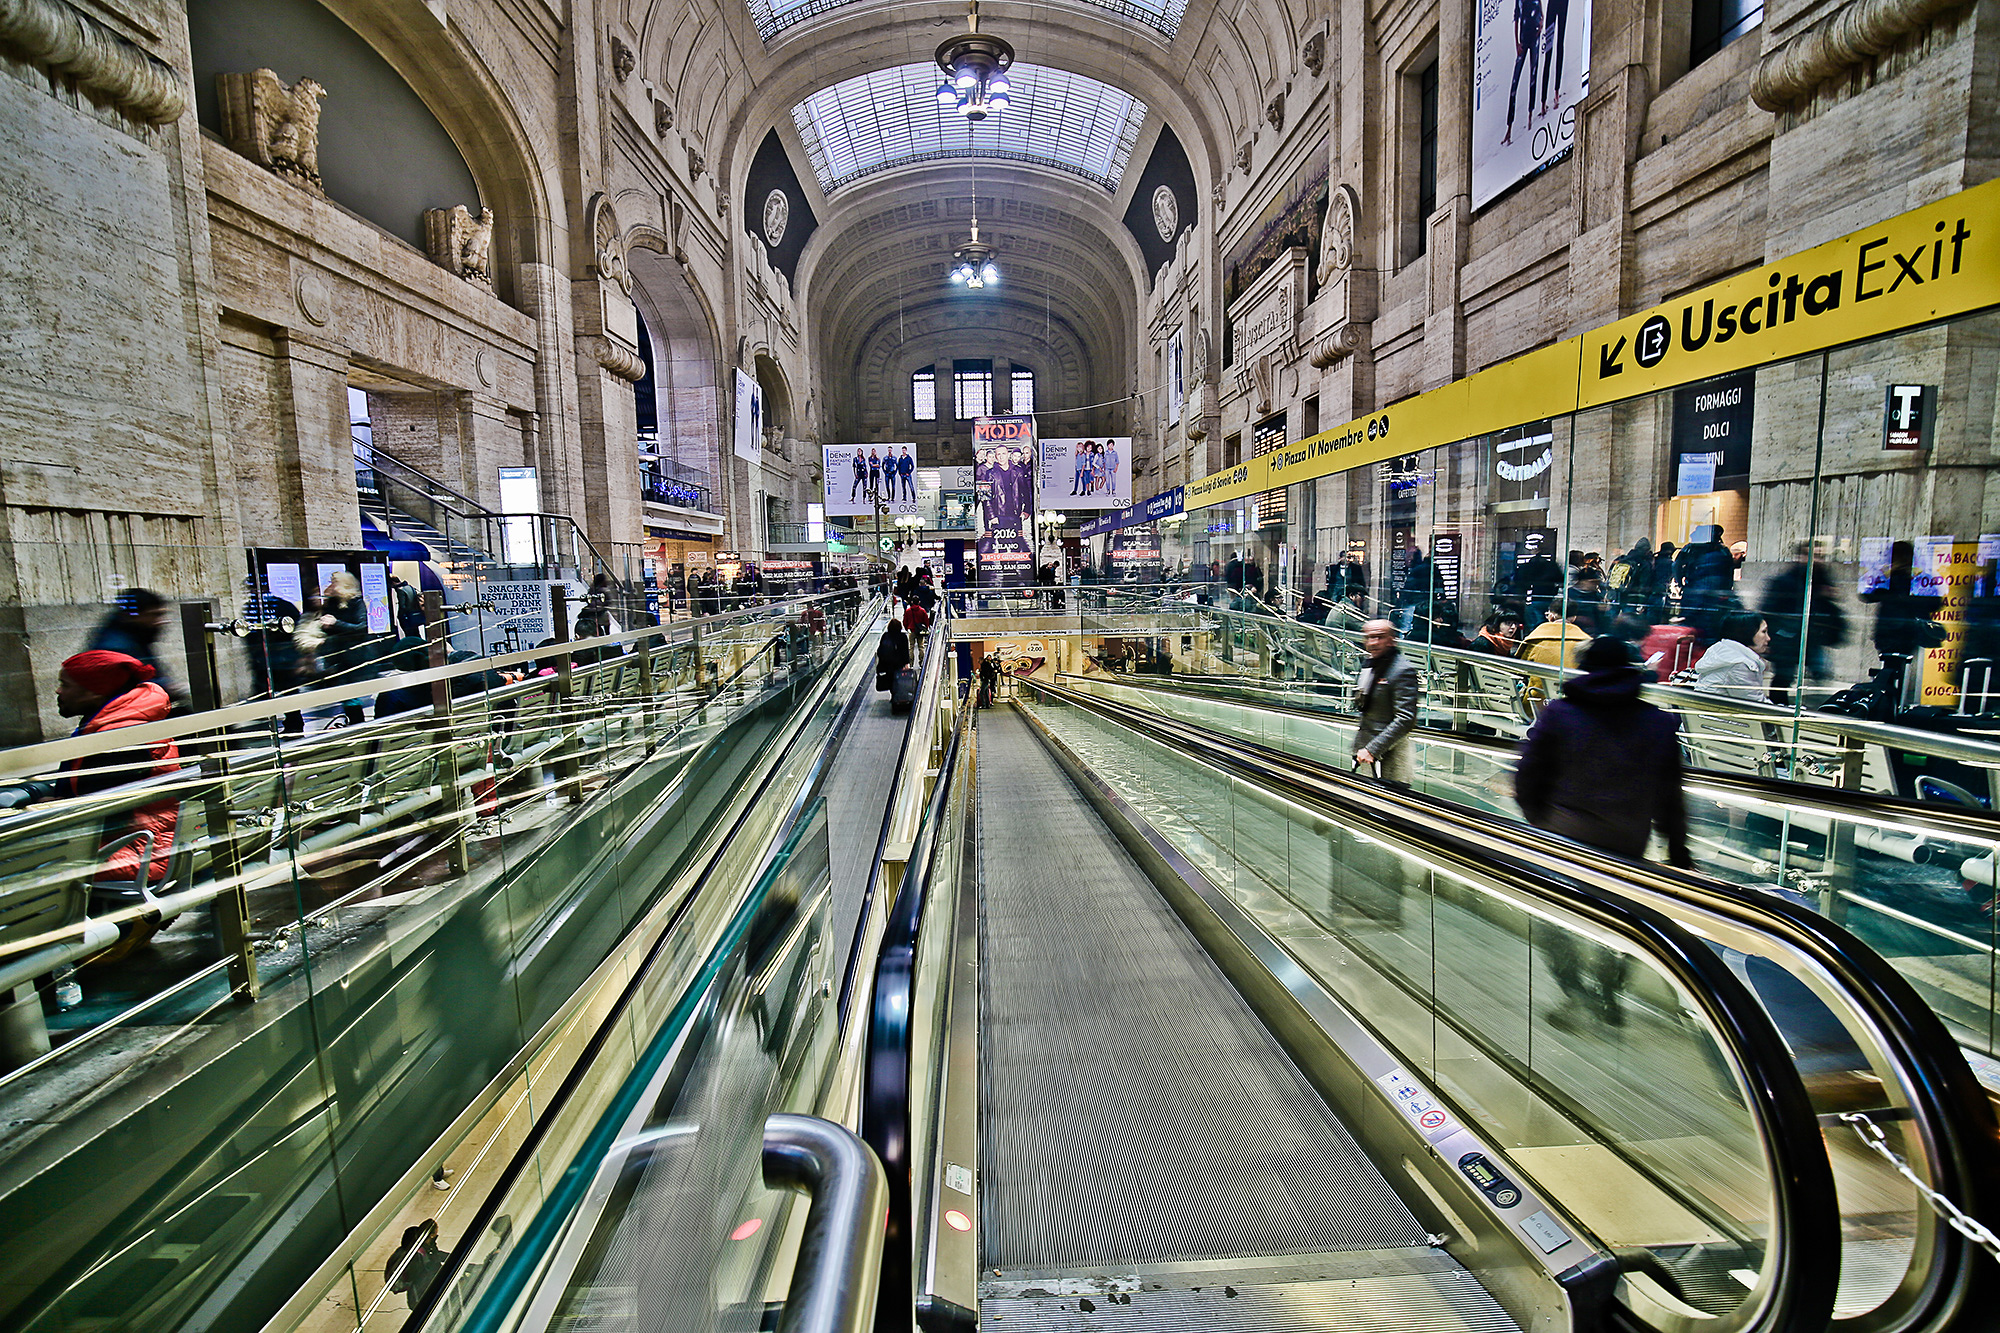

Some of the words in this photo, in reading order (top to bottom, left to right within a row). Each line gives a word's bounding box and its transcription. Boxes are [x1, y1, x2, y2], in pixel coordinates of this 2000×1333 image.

[1531, 104, 1575, 160] OVS
[1681, 272, 1843, 352] Uscita
[1855, 218, 1971, 303] Exit
[1695, 387, 1742, 413] FORMAGGI
[1894, 386, 1921, 430] T
[1703, 421, 1730, 440] DOLCI
[1284, 451, 1307, 467] Piazza
[1308, 442, 1317, 459] IV
[1318, 429, 1364, 456] Novembre
[1496, 447, 1553, 482] CENTRALE
[1705, 450, 1724, 466] VINI
[899, 504, 917, 513] OVS
[1112, 498, 1131, 507] OVS
[993, 528, 1018, 539] 2016
[1016, 563, 1031, 571] SIRO
[481, 592, 541, 601] RESTAURANT
[488, 585, 520, 593] SNACK
[521, 584, 541, 592] BAR
